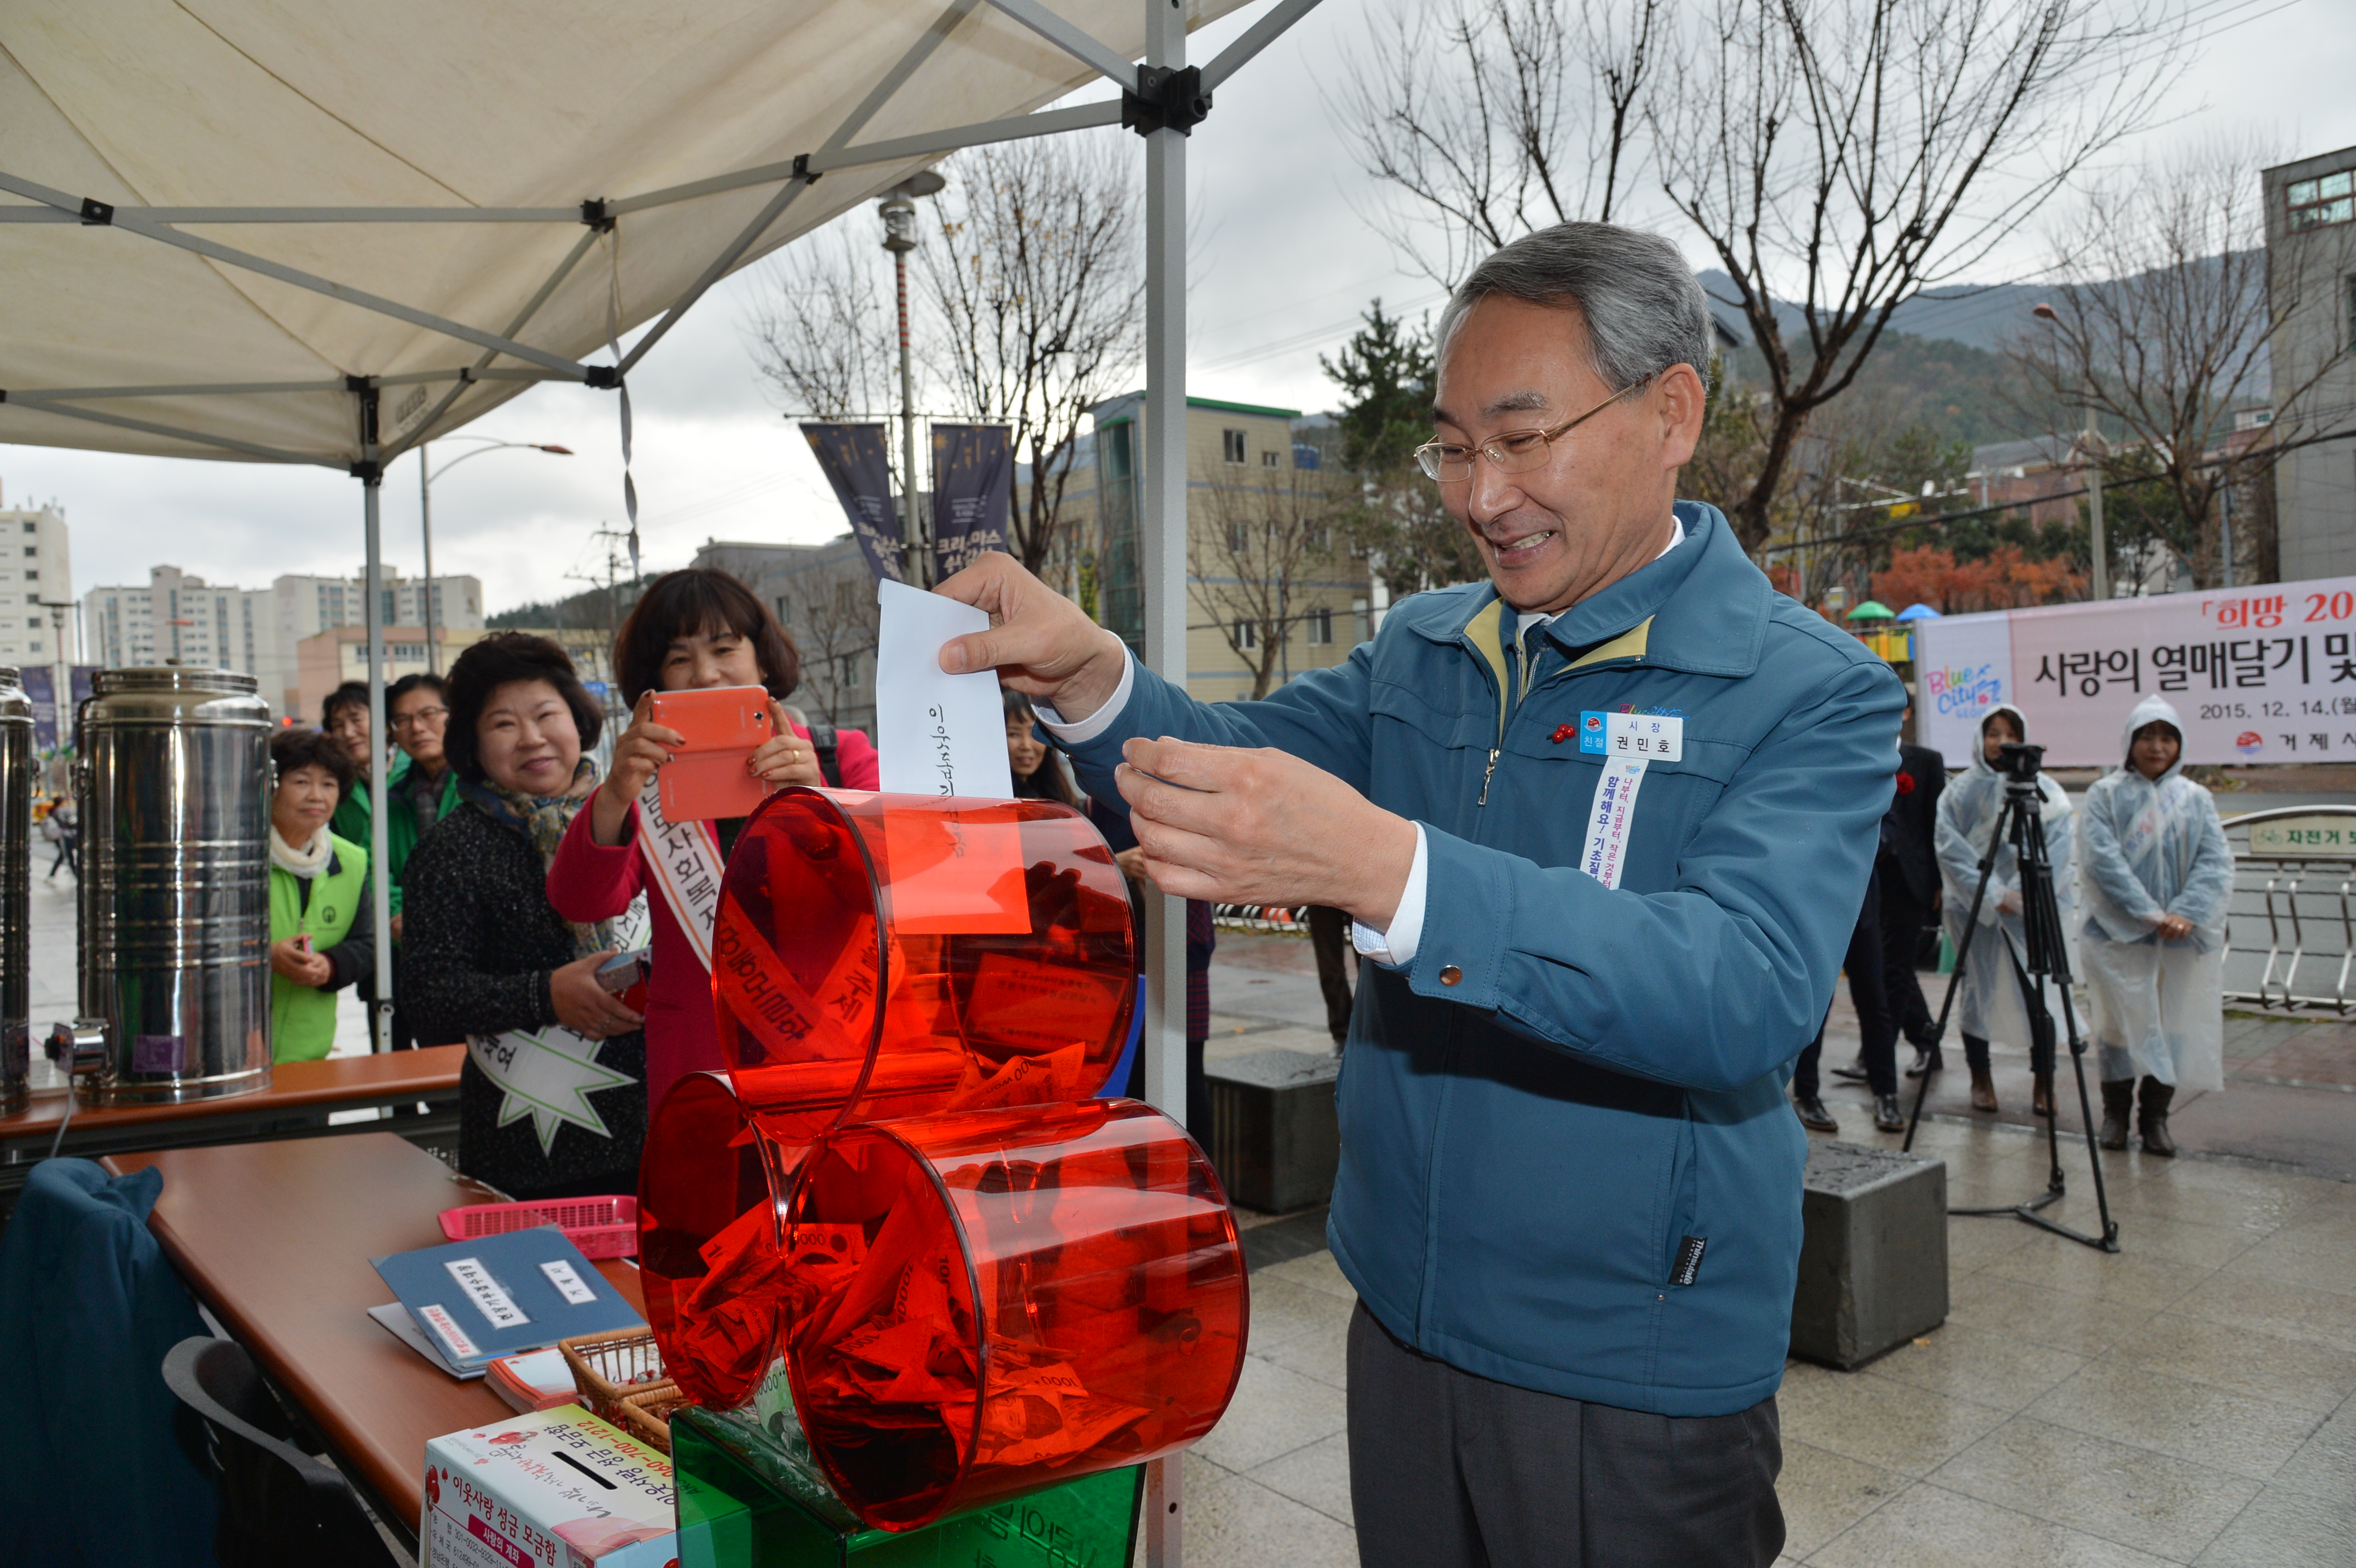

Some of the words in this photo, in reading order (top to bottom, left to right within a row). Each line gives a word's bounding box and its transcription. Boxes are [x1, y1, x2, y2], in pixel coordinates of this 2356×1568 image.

[2035, 648, 2140, 697] 사랑의
[2152, 635, 2310, 692] 열매달기
[1925, 665, 1974, 696] Blue
[1938, 686, 1976, 714] City
[2200, 703, 2251, 719] 2015.
[2262, 701, 2291, 717] 12.
[1583, 736, 1604, 748] 친절
[2287, 829, 2340, 845] 자전거
[1607, 844, 1619, 861] 작은
[1683, 1240, 1705, 1285] Thinsulate
[543, 1423, 592, 1449] 모금함
[585, 1448, 624, 1467] 성금
[452, 1476, 494, 1521] 이웃사랑
[497, 1507, 519, 1539] 성금
[523, 1524, 557, 1567] 모금함
[482, 1527, 502, 1553] 사랑의
[505, 1544, 520, 1564] 계좌
